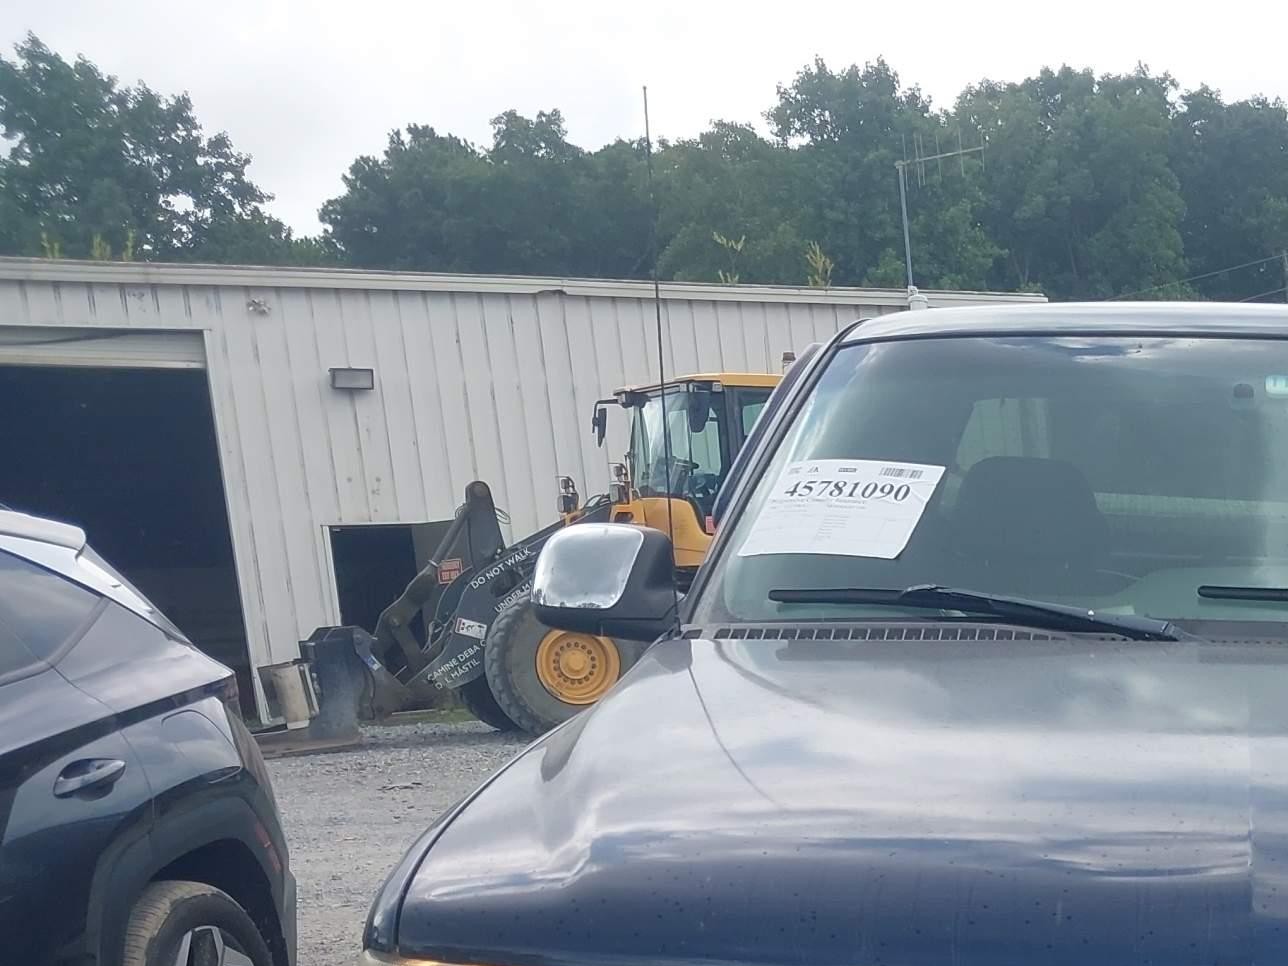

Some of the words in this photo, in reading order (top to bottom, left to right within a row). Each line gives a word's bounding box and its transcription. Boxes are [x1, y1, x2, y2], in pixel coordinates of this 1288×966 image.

[784, 480, 911, 501] 45781090
[471, 576, 486, 590] DO
[485, 563, 505, 580] NOT
[505, 547, 531, 566] WALK
[494, 588, 522, 613] UNDER
[427, 658, 458, 681] CAMINE
